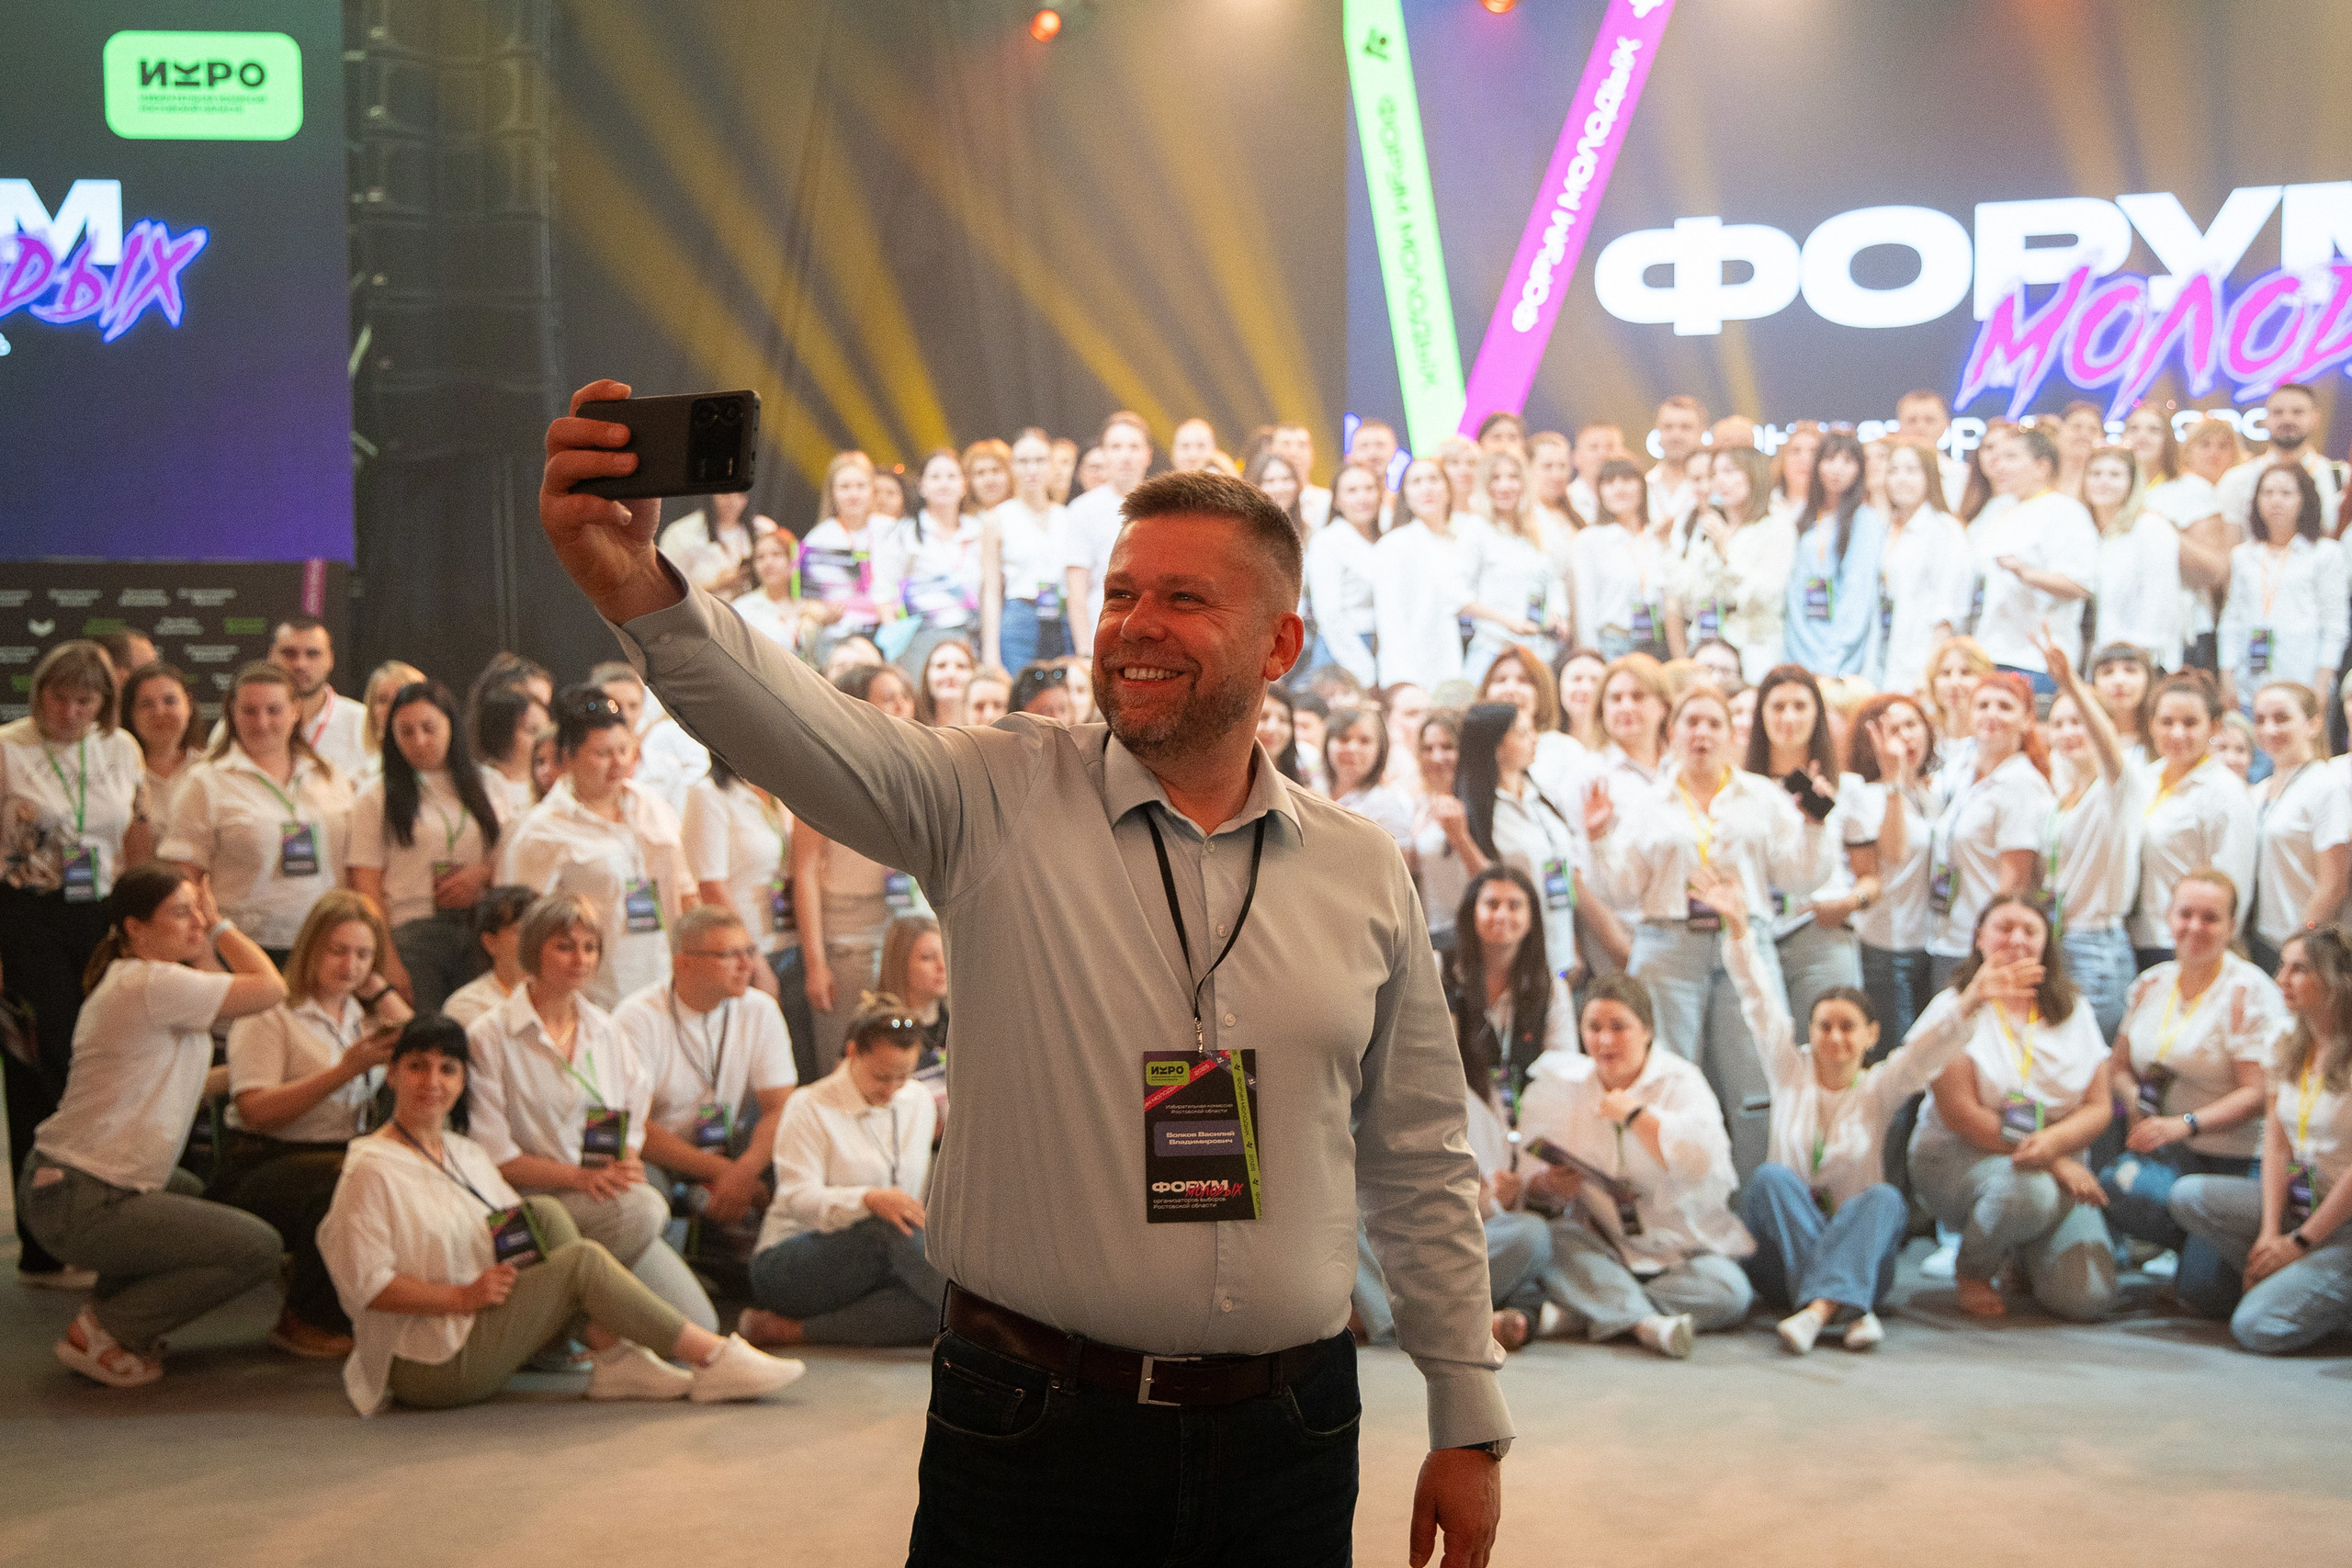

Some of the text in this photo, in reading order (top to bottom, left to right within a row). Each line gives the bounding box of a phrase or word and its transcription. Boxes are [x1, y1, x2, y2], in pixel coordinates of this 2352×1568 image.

[1511, 36, 1643, 333] ФОРУМ МОЛОДЫХ
[1377, 96, 1440, 389] ФОРУМ МОЛОДЫХ
[1237, 1077, 1245, 1102] ФОРУМ
[1240, 1102, 1250, 1137] МОЛОДЫХ
[1151, 1179, 1228, 1193] ФОРУМ
[1185, 1183, 1244, 1198] МОЛОДЫХ
